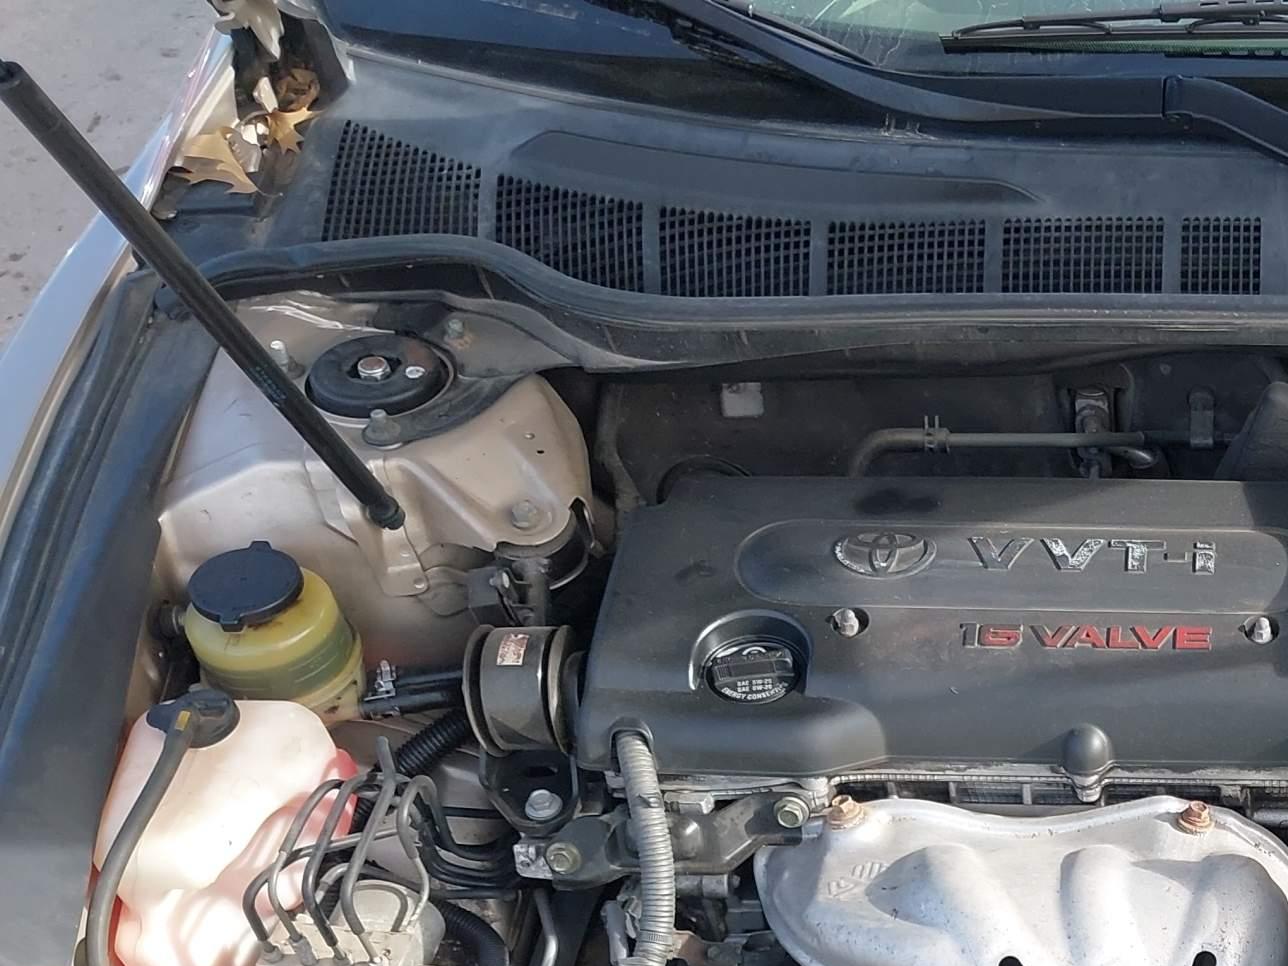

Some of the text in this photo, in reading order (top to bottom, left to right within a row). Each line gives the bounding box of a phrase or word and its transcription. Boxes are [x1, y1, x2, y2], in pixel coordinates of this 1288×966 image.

[967, 536, 1216, 575] VVT-i
[959, 622, 1212, 650] 16 VALVE
